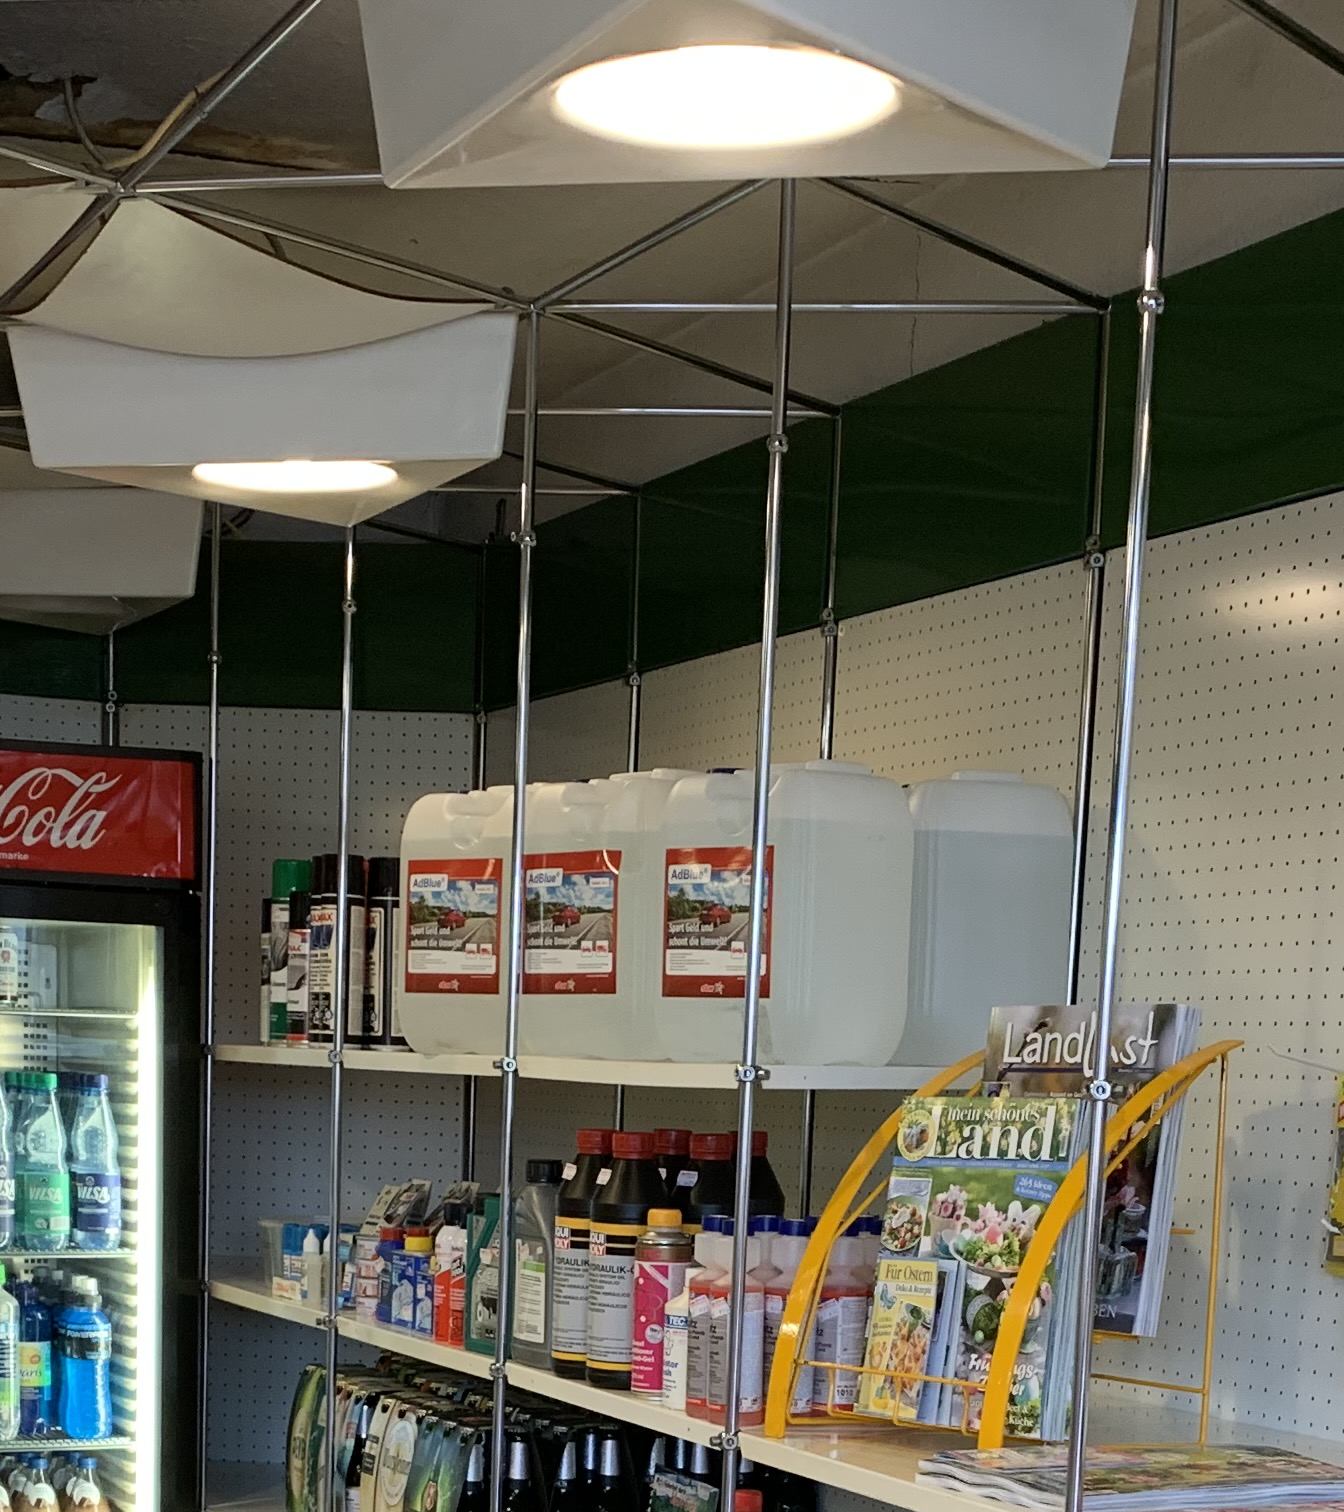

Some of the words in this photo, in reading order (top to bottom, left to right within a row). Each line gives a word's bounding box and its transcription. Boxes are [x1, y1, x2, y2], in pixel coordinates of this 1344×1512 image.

[528, 872, 558, 886] AdBlue
[671, 867, 706, 882] AdBlue
[412, 877, 443, 890] AdBlue
[411, 926, 425, 936] Spart
[669, 923, 685, 935] Spart
[686, 923, 701, 934] Geld
[702, 923, 714, 933] und
[428, 937, 438, 948] die
[669, 935, 687, 947] schont
[689, 935, 699, 947] die
[947, 1103, 981, 1121] mein
[984, 1103, 1041, 1122] schönes
[925, 1105, 1058, 1162] Land
[30, 1187, 63, 1201] VILSA
[77, 1186, 109, 1200] VILSA
[885, 1263, 903, 1281] Für
[903, 1265, 933, 1283] Ostern
